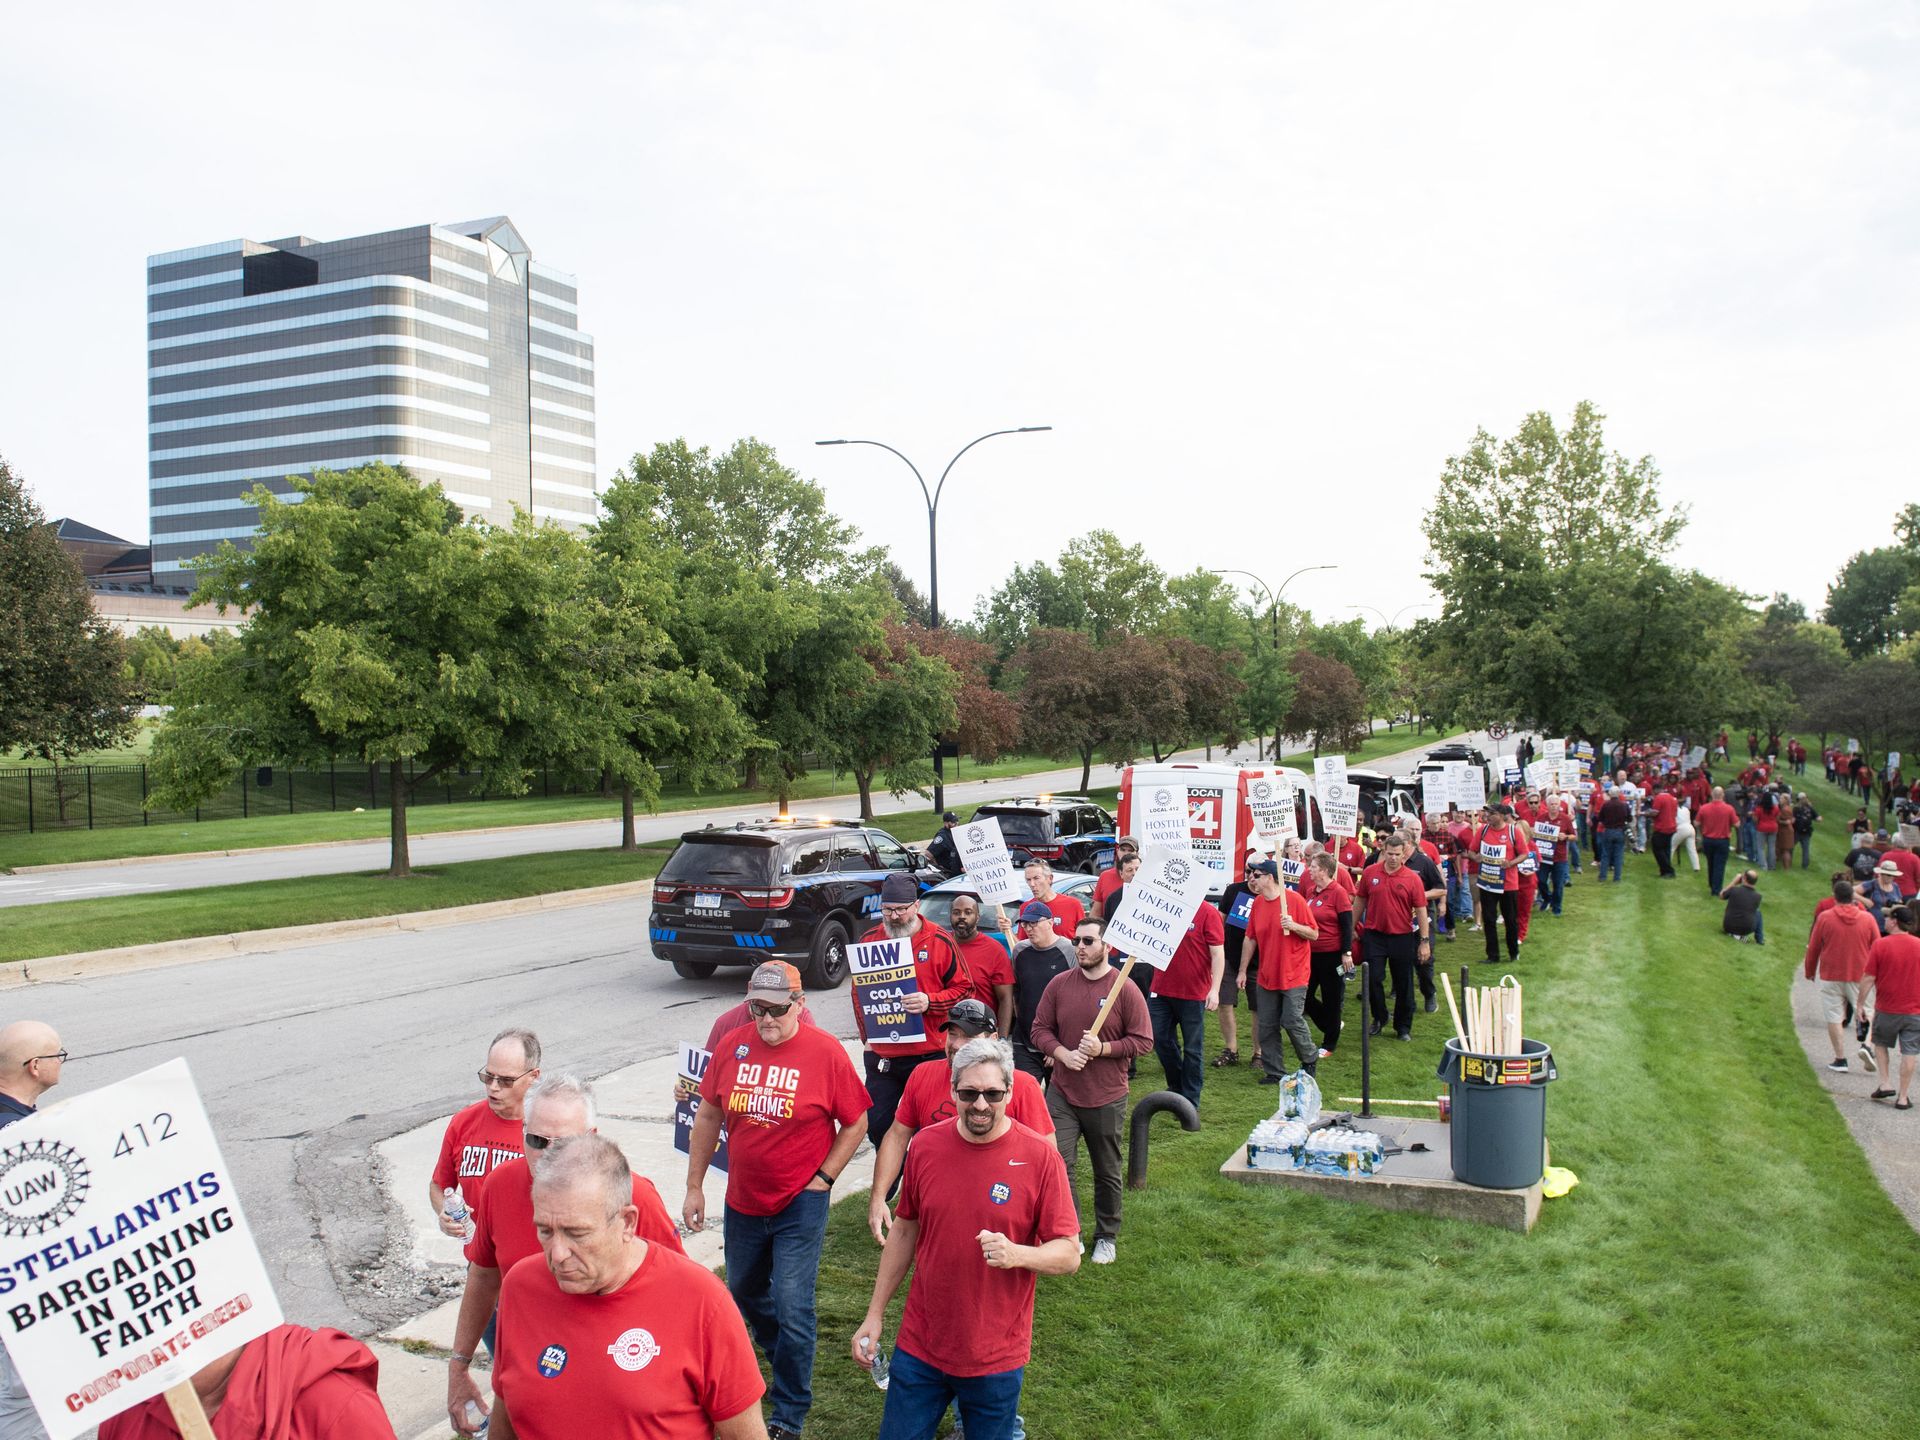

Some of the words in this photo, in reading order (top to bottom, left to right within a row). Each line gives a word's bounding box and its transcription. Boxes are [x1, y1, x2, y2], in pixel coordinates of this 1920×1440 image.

[1252, 798, 1292, 808] STELLANTIS
[1325, 801, 1356, 809] STELLANTIS
[1189, 800, 1218, 836] 4
[1254, 806, 1293, 816] BARGAINING
[1325, 808, 1356, 816] BARGAINING
[1145, 819, 1186, 830] HOSTILE
[1265, 821, 1285, 829] FAITH
[1538, 824, 1555, 835] UAW
[1152, 831, 1182, 840] WORK
[1483, 845, 1502, 857] UAW
[965, 854, 1008, 872] BARGAINING
[1283, 860, 1299, 874] AW
[973, 872, 984, 883] IN
[986, 867, 1006, 880] BAD
[1171, 866, 1183, 876] UAW
[980, 880, 1008, 894] FAITH
[1153, 879, 1172, 892] LOCAL
[1173, 888, 1184, 896] 412
[861, 894, 882, 913] POL
[1138, 889, 1183, 918] UNFAIR
[685, 908, 730, 918] POLICE
[1132, 909, 1170, 933] LABOR
[1111, 920, 1174, 956] PRACTICES
[857, 942, 900, 968] UAW
[857, 973, 892, 984] STAND
[896, 969, 911, 978] UP
[869, 987, 904, 1000] COLA
[863, 1003, 891, 1015] FAIR
[876, 1013, 906, 1025] NOW
[688, 1049, 710, 1078] UA
[737, 1063, 762, 1085] GO
[766, 1066, 800, 1091] BIG
[680, 1080, 700, 1092] STA
[754, 1086, 763, 1094] OR
[728, 1092, 794, 1119] MAHOMES
[678, 1112, 694, 1128] FA
[113, 1112, 178, 1159] 412
[485, 1140, 520, 1149] DETROIT
[460, 1145, 489, 1177] RED
[5, 1170, 56, 1206] UAW
[0, 1172, 221, 1294] STELLANTIS
[8, 1207, 234, 1333] BARGAINING
[72, 1298, 115, 1334] IN
[125, 1257, 197, 1311] BAD
[90, 1285, 202, 1358] FAITH
[65, 1332, 191, 1414] CORPORATE
[191, 1293, 252, 1340] GREED
[545, 1346, 566, 1361] 97%
[541, 1359, 561, 1371] STRIKE
